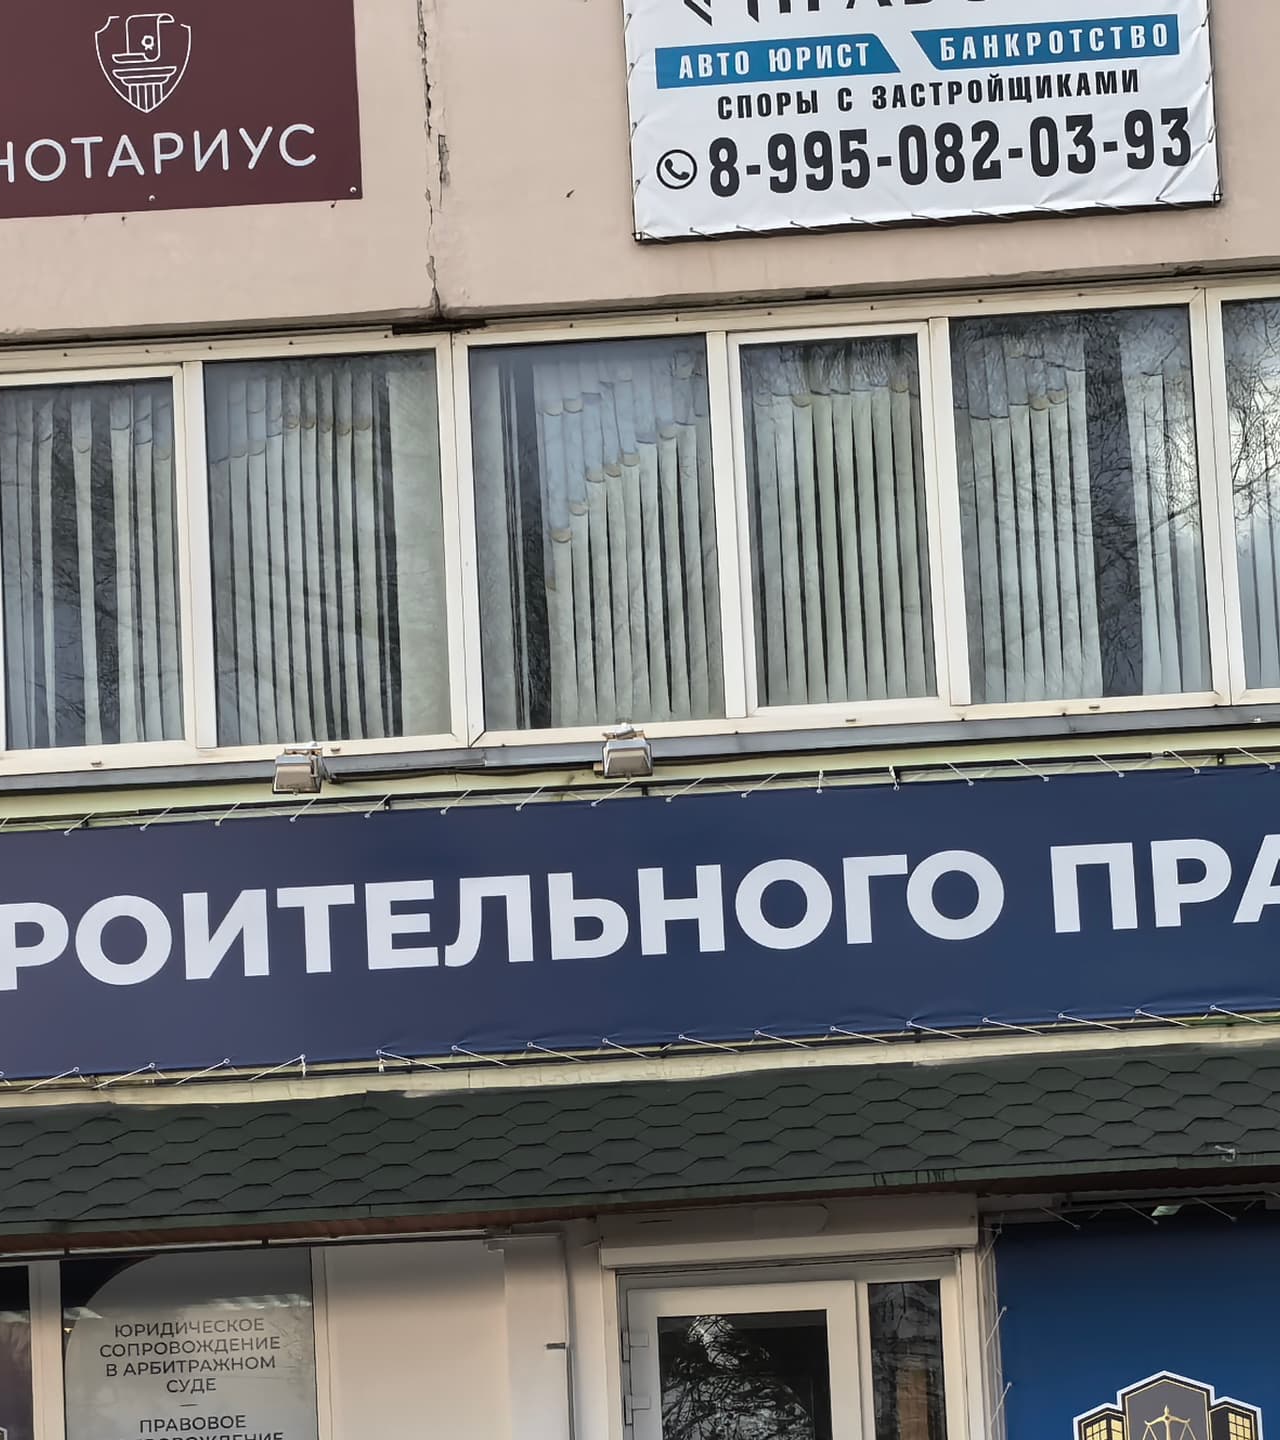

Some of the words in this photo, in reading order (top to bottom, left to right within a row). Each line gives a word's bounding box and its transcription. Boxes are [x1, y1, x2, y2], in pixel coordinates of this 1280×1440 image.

[678, 49, 750, 80] АВТО
[769, 42, 870, 73] ЮРИСТ
[940, 24, 1168, 62] БАНКРОТСТВО
[718, 91, 819, 120] СПОРЫ
[837, 88, 853, 112] С
[873, 68, 1139, 110] ЗАСТРОЙЩИКАМИ
[709, 106, 1193, 198] 8-995-082-03-93
[114, 1317, 265, 1339] ЮРИДИЧЕСКОЕ
[99, 1336, 281, 1359] СОПРОВОЖДЕНИЕ
[106, 1363, 118, 1377] В
[123, 1355, 276, 1376] АРБИТРАЖНОМ
[166, 1377, 217, 1394] СУДЕ
[139, 1414, 246, 1433] ПРАВОВОЕ
